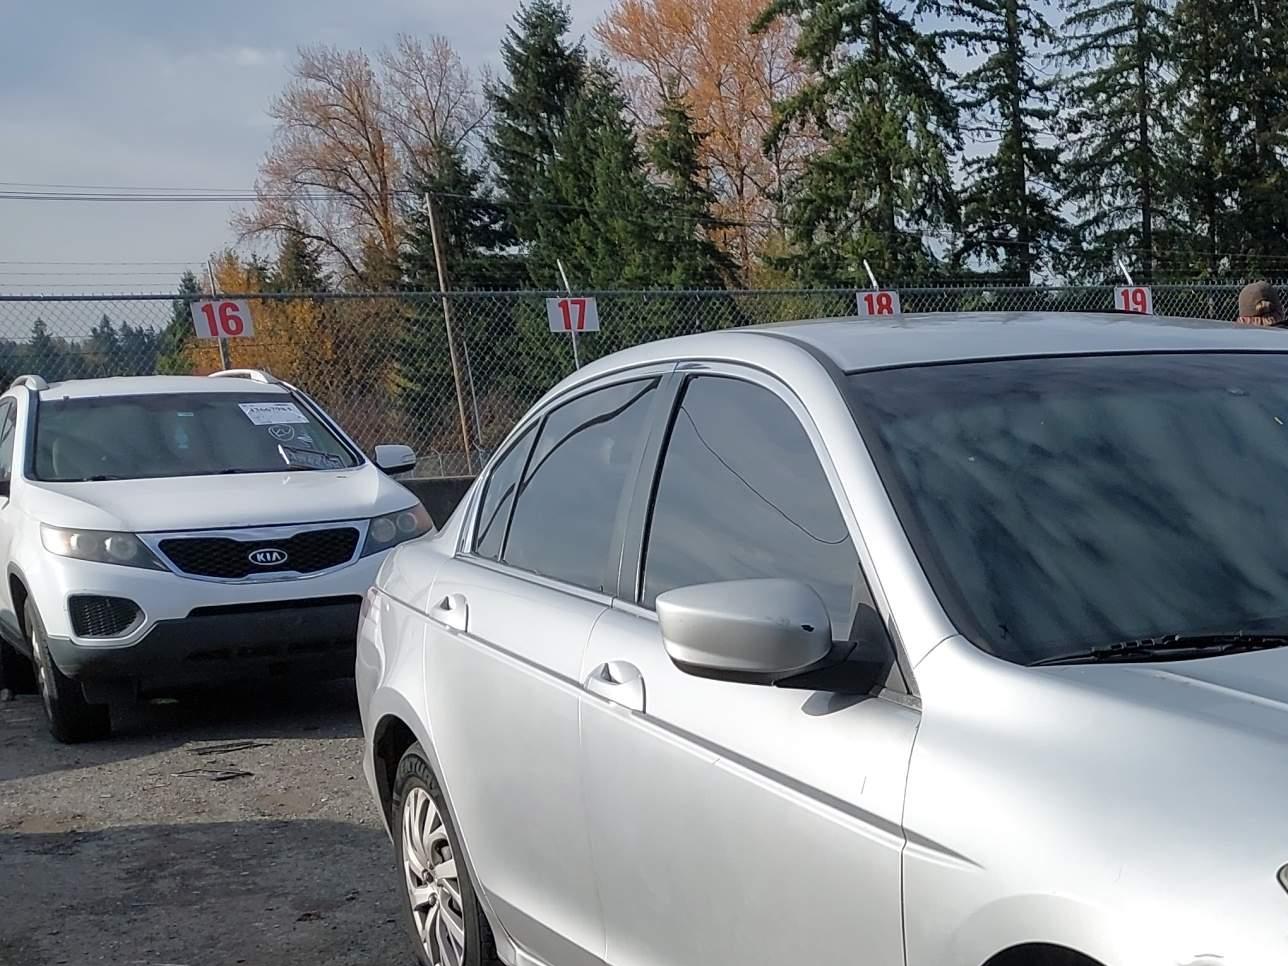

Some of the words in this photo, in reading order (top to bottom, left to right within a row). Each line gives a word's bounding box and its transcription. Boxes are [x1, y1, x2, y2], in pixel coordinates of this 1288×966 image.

[864, 291, 894, 316] 18
[1121, 287, 1147, 313] 19
[201, 301, 244, 338] 16
[559, 298, 587, 331] 17
[256, 551, 282, 562] KIA
